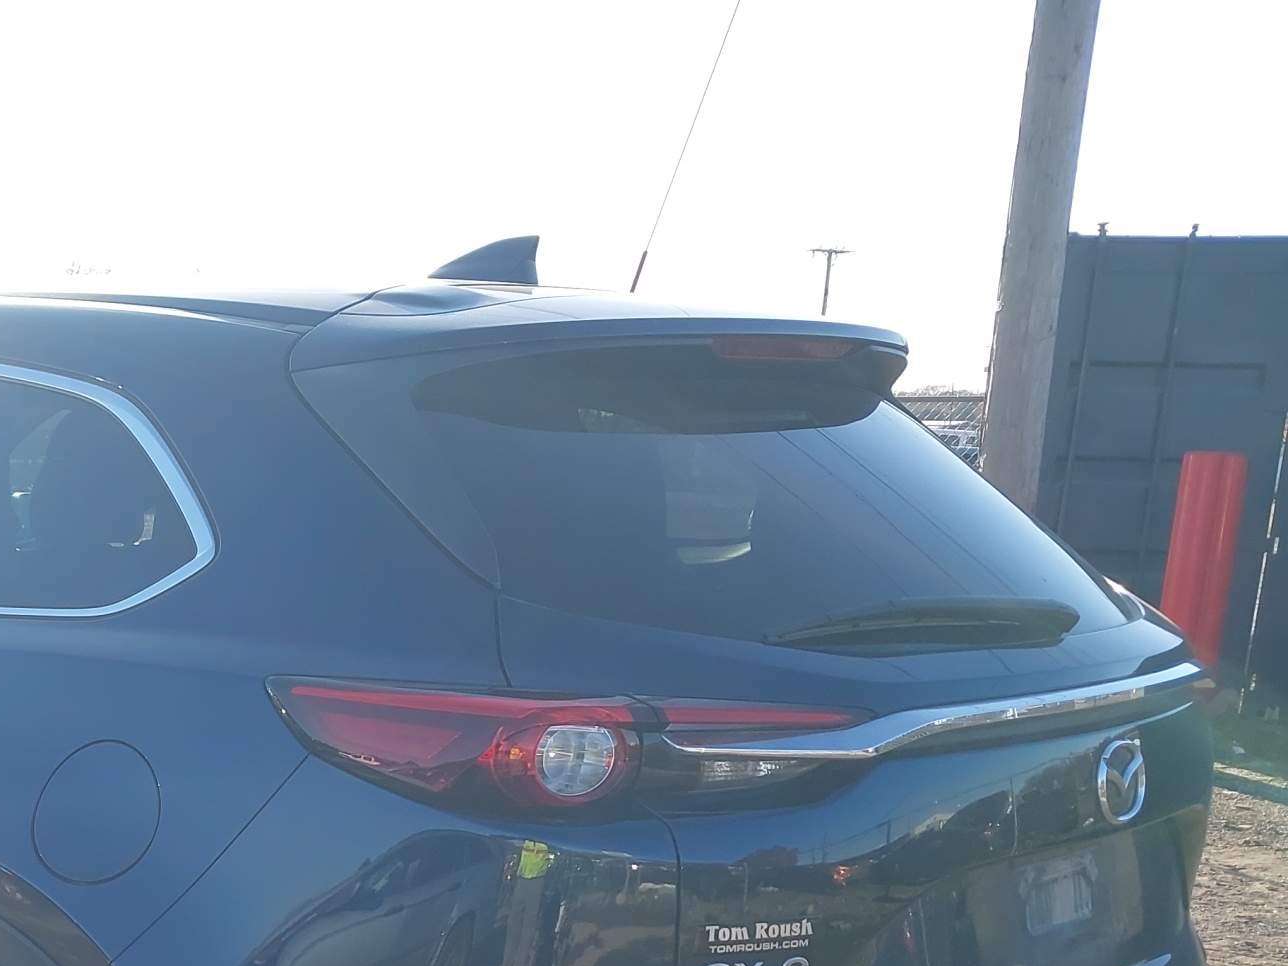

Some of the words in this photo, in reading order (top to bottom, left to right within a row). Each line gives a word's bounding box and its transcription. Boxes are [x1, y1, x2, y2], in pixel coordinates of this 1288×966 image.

[706, 925, 749, 942] Tom
[755, 918, 813, 939] Roush
[710, 939, 809, 953] TOMROUSH.COM
